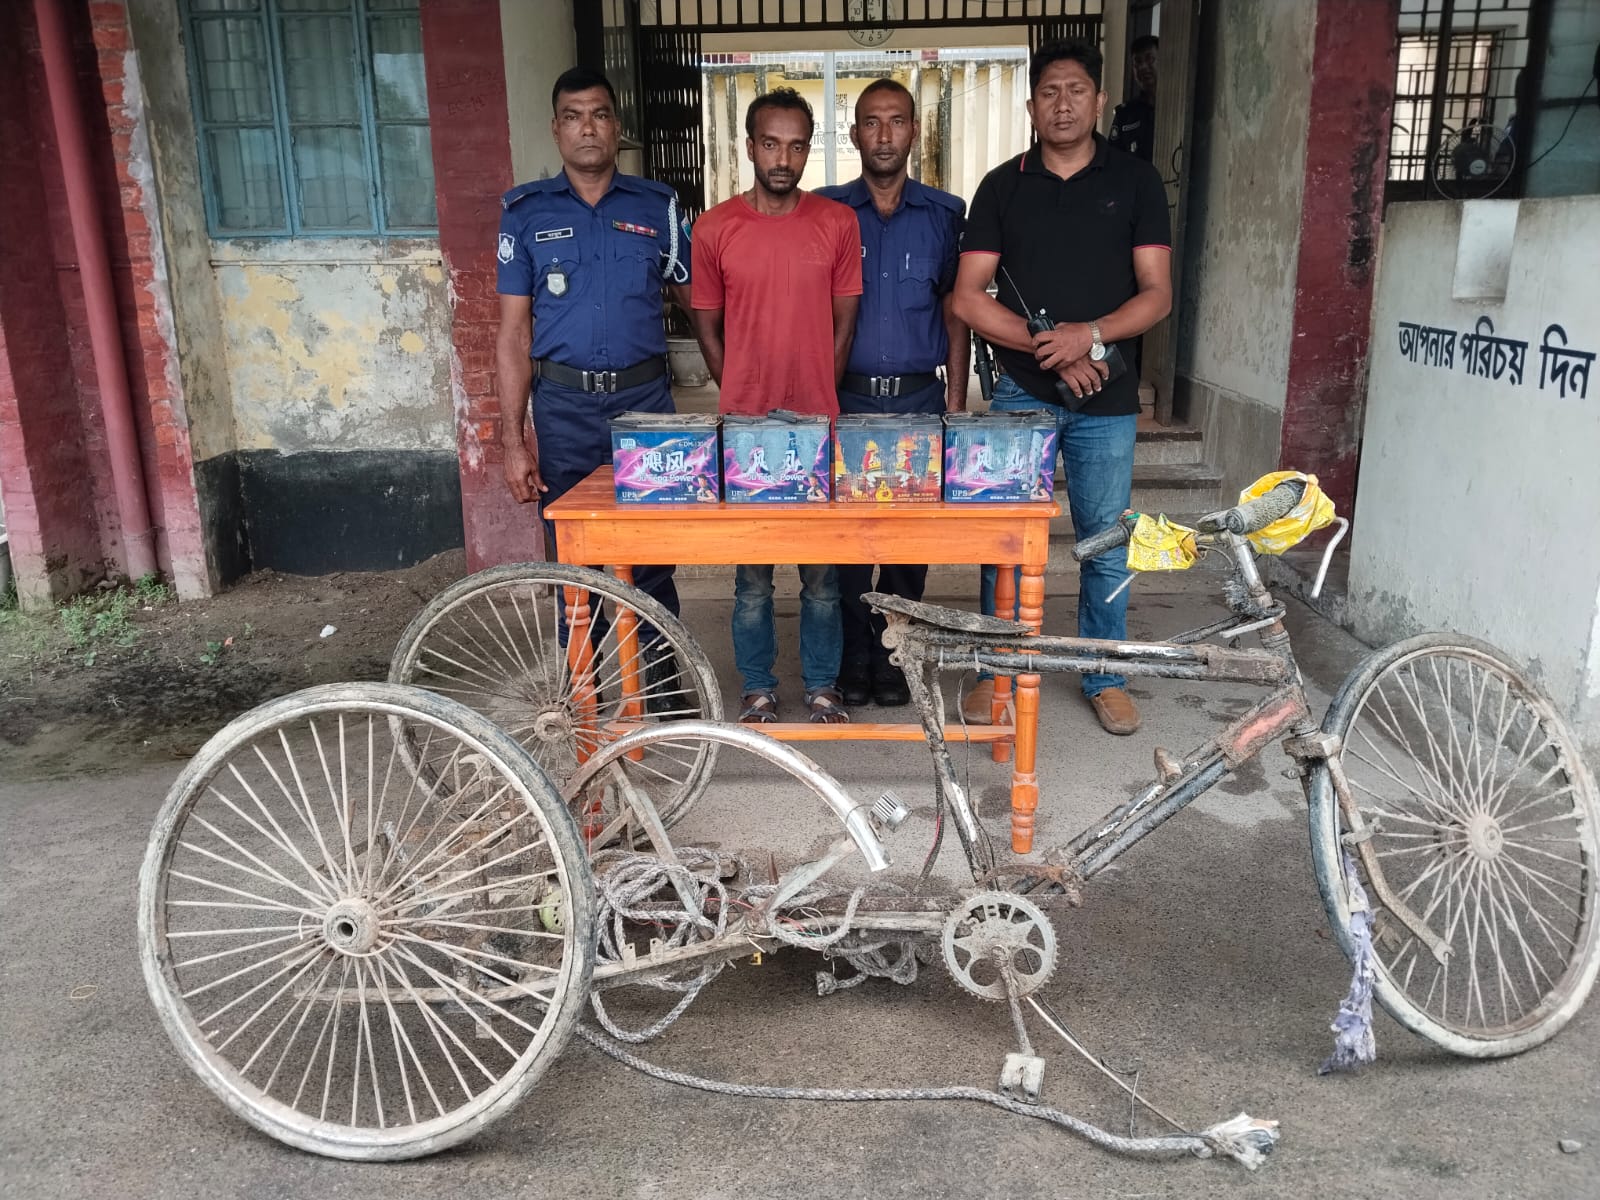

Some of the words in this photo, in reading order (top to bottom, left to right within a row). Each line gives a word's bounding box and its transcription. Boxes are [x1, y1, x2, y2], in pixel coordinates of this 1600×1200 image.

[1398, 321, 1458, 370] আপনার
[1459, 315, 1529, 386] পরিচয়
[1539, 323, 1597, 399] দিন
[669, 474, 695, 482] Power
[951, 489, 968, 497] UPS
